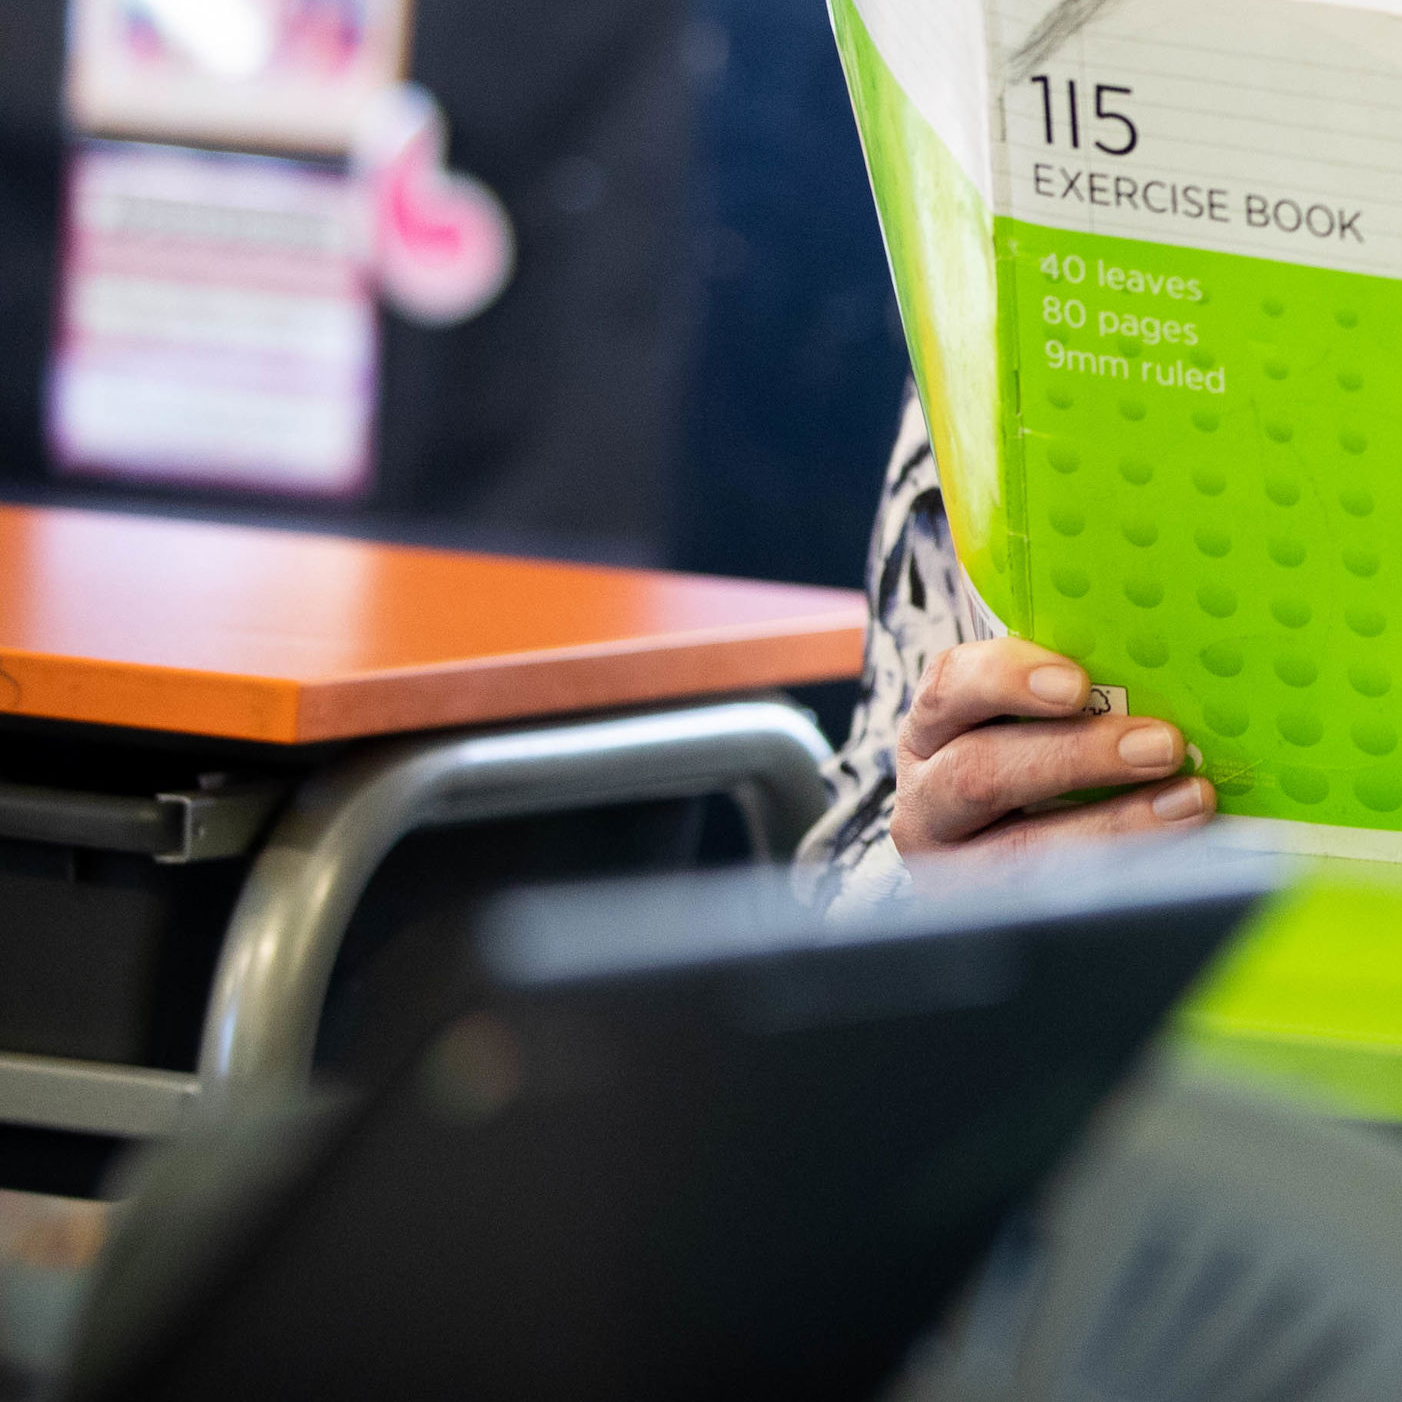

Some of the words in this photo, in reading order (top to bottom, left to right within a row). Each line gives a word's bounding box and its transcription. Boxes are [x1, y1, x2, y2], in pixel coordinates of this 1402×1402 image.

[1031, 75, 1139, 156] 115
[1033, 162, 1231, 223] EXERCISE
[1245, 194, 1366, 245] BOOK
[1040, 253, 1086, 284] 40
[1097, 259, 1203, 301] leaves
[1042, 295, 1086, 329] 80
[1099, 310, 1198, 346] pages
[1045, 339, 1129, 380] 9mm
[1141, 359, 1226, 394] ruled
